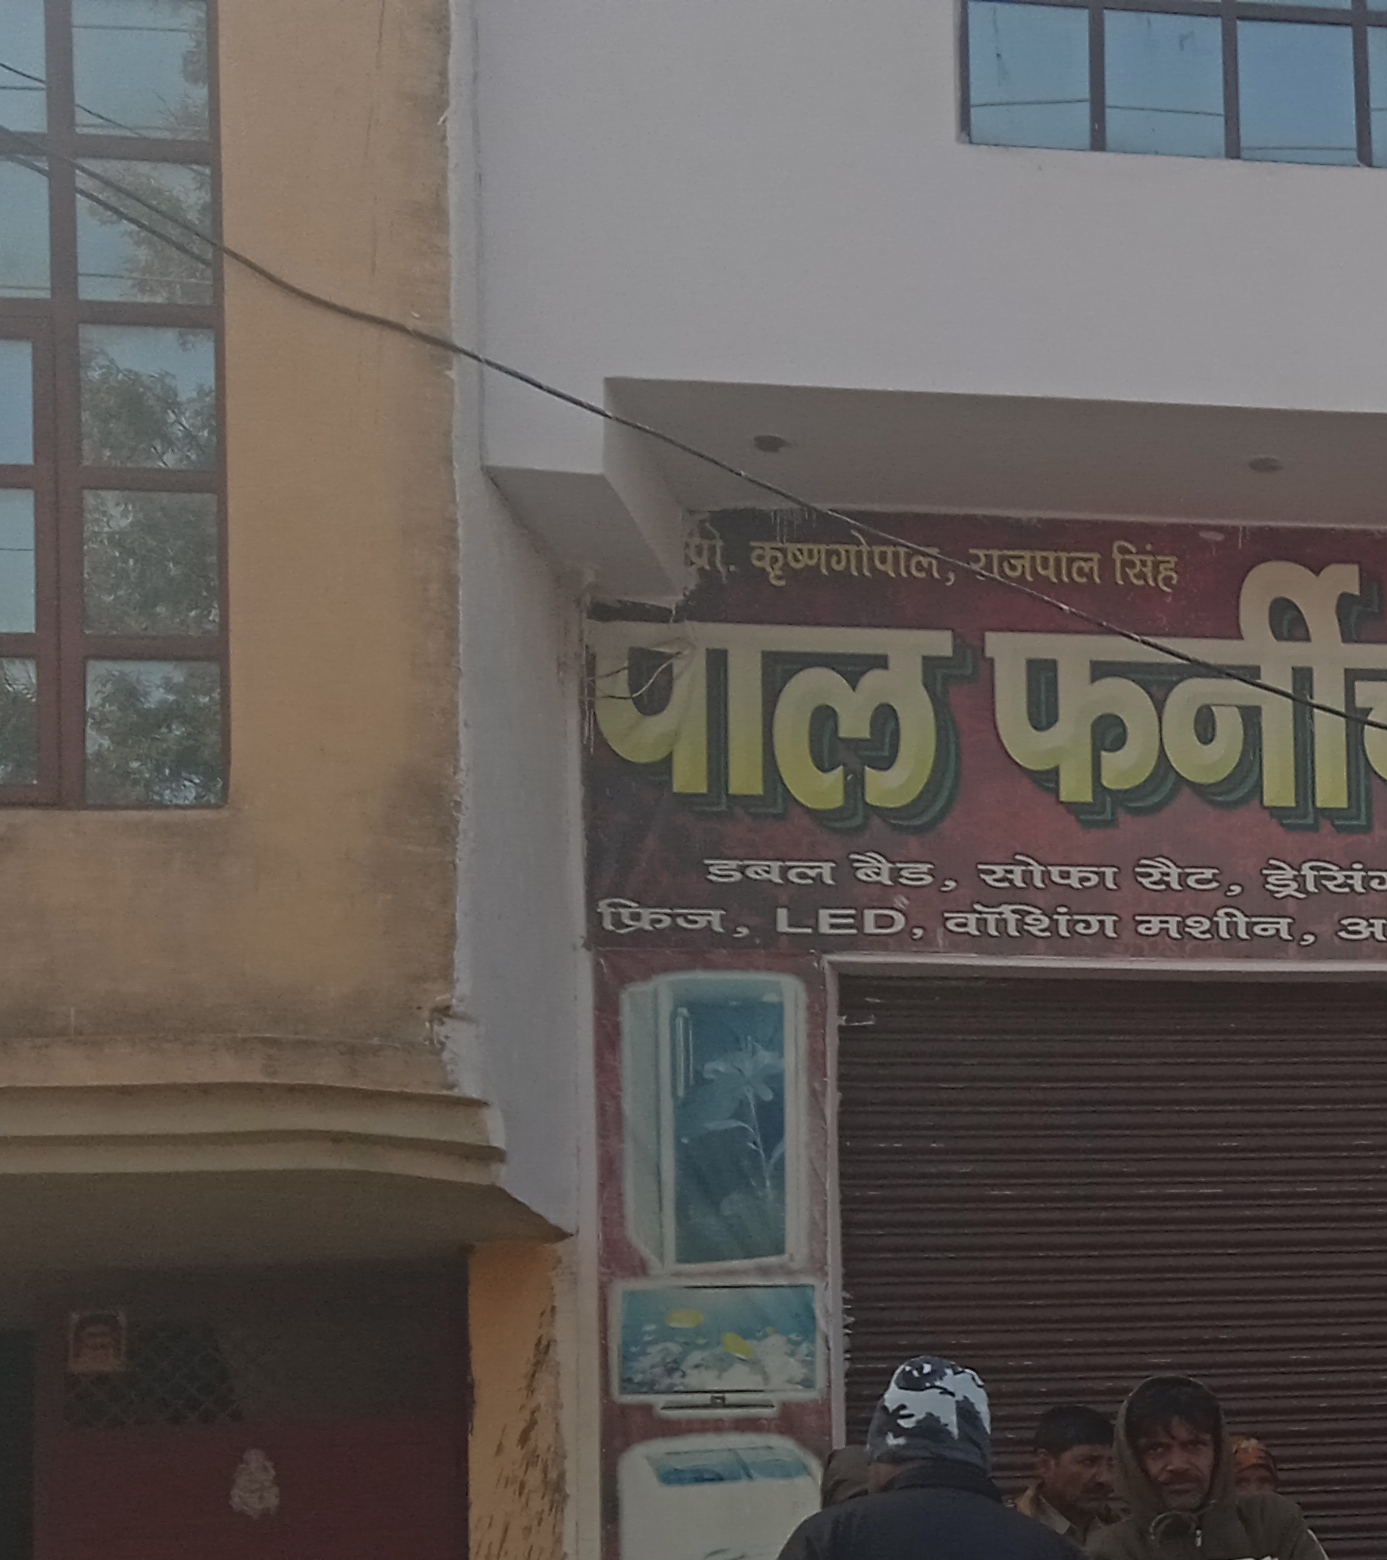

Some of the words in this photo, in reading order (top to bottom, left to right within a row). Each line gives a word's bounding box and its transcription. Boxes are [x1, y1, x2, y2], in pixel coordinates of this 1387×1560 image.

[749, 530, 955, 587] कृष्णगोपाल,
[969, 548, 1101, 584] राजपाल
[1112, 540, 1178, 593] सिंह
[588, 618, 954, 811] पाल
[703, 858, 836, 886] डबल
[848, 851, 957, 892] बैड,
[976, 854, 1119, 890] सोफा
[1134, 856, 1243, 897] सैट,
[597, 898, 750, 938] फ्रिज,
[775, 908, 923, 939] LED,
[943, 903, 1118, 938] वॉशिंग
[1134, 907, 1316, 946] मशीन,
